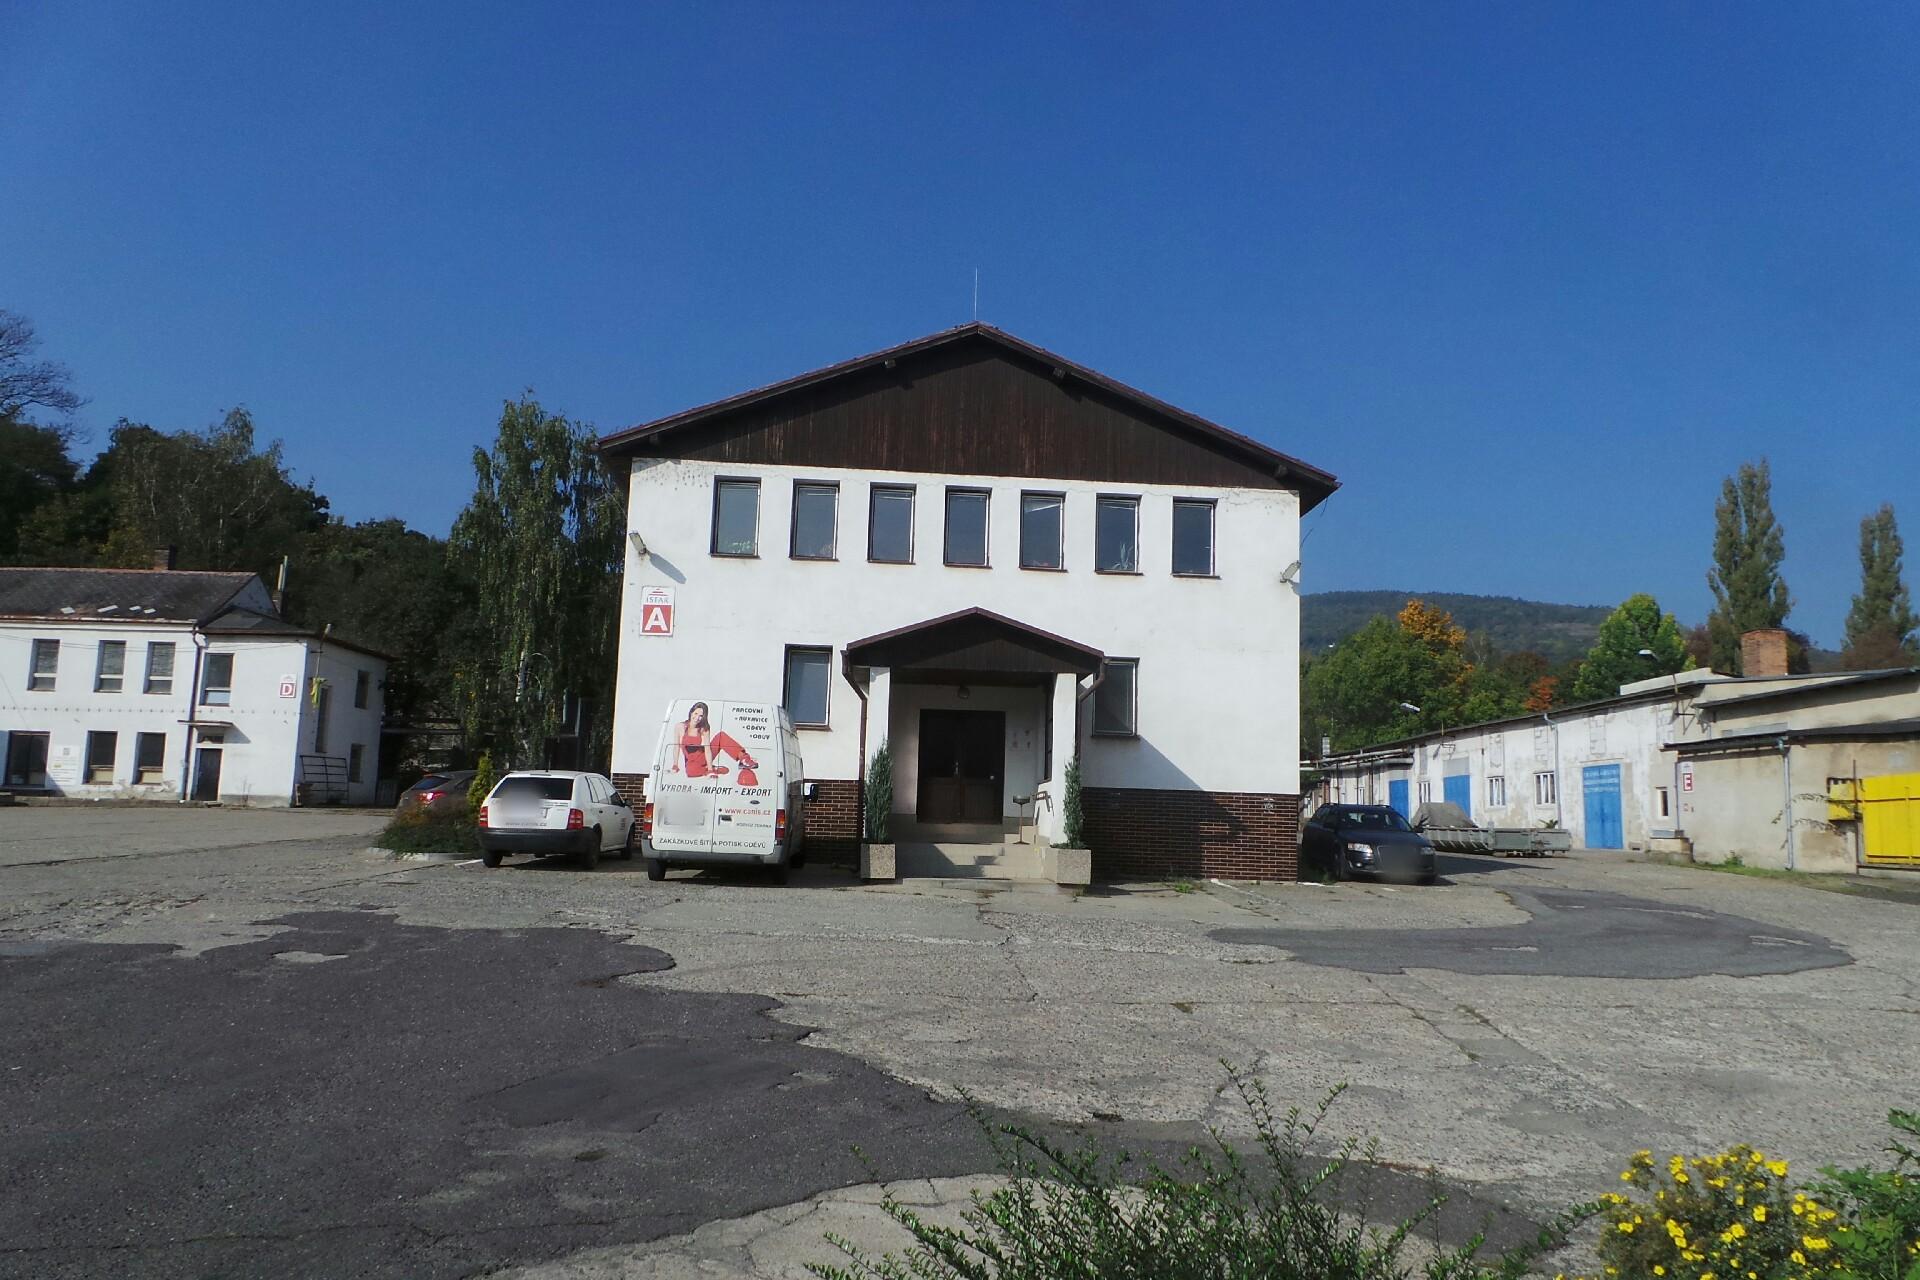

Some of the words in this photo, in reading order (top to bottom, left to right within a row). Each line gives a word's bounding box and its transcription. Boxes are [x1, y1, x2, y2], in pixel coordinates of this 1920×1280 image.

[644, 607, 668, 631] A
[282, 683, 293, 695] D
[1683, 773, 1692, 790] E
[700, 786, 733, 795] IMPORT
[741, 788, 772, 797] EXPORT
